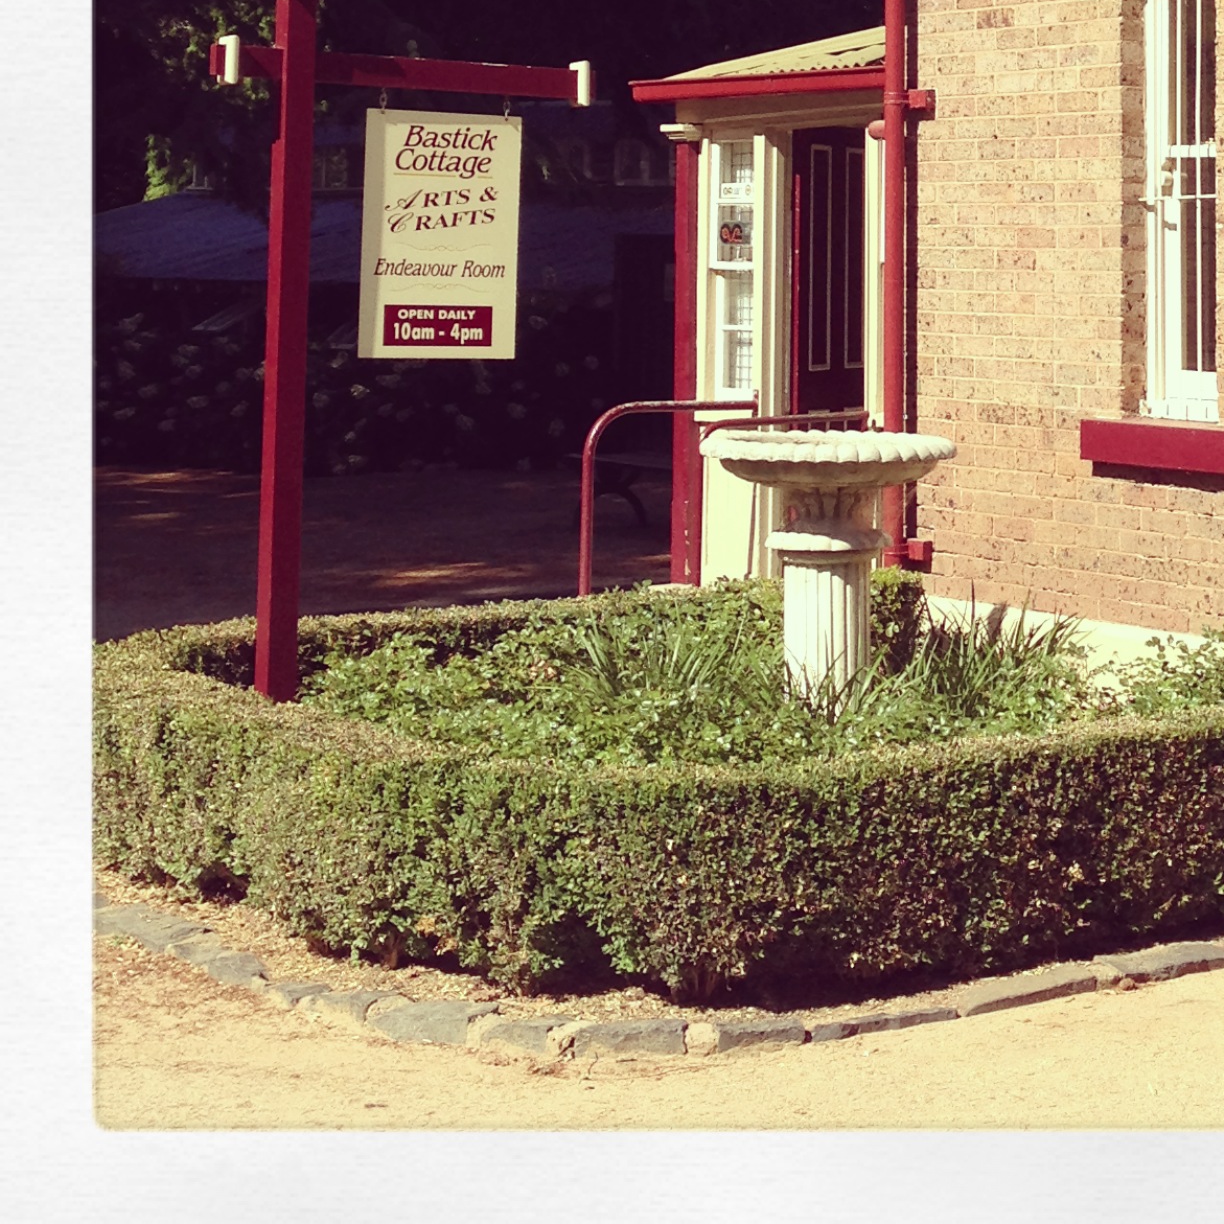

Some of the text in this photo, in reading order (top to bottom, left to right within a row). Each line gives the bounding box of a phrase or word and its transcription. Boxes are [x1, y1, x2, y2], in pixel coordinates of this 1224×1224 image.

[403, 125, 498, 151] Bastick
[395, 148, 492, 179] Cottage
[384, 186, 499, 212] ARTS &
[387, 208, 496, 234] CRAFTS
[373, 257, 506, 279] Endeavour Room
[397, 308, 476, 321] OPEN DAILY
[393, 322, 435, 340] 10am
[449, 323, 483, 344] 4pm
